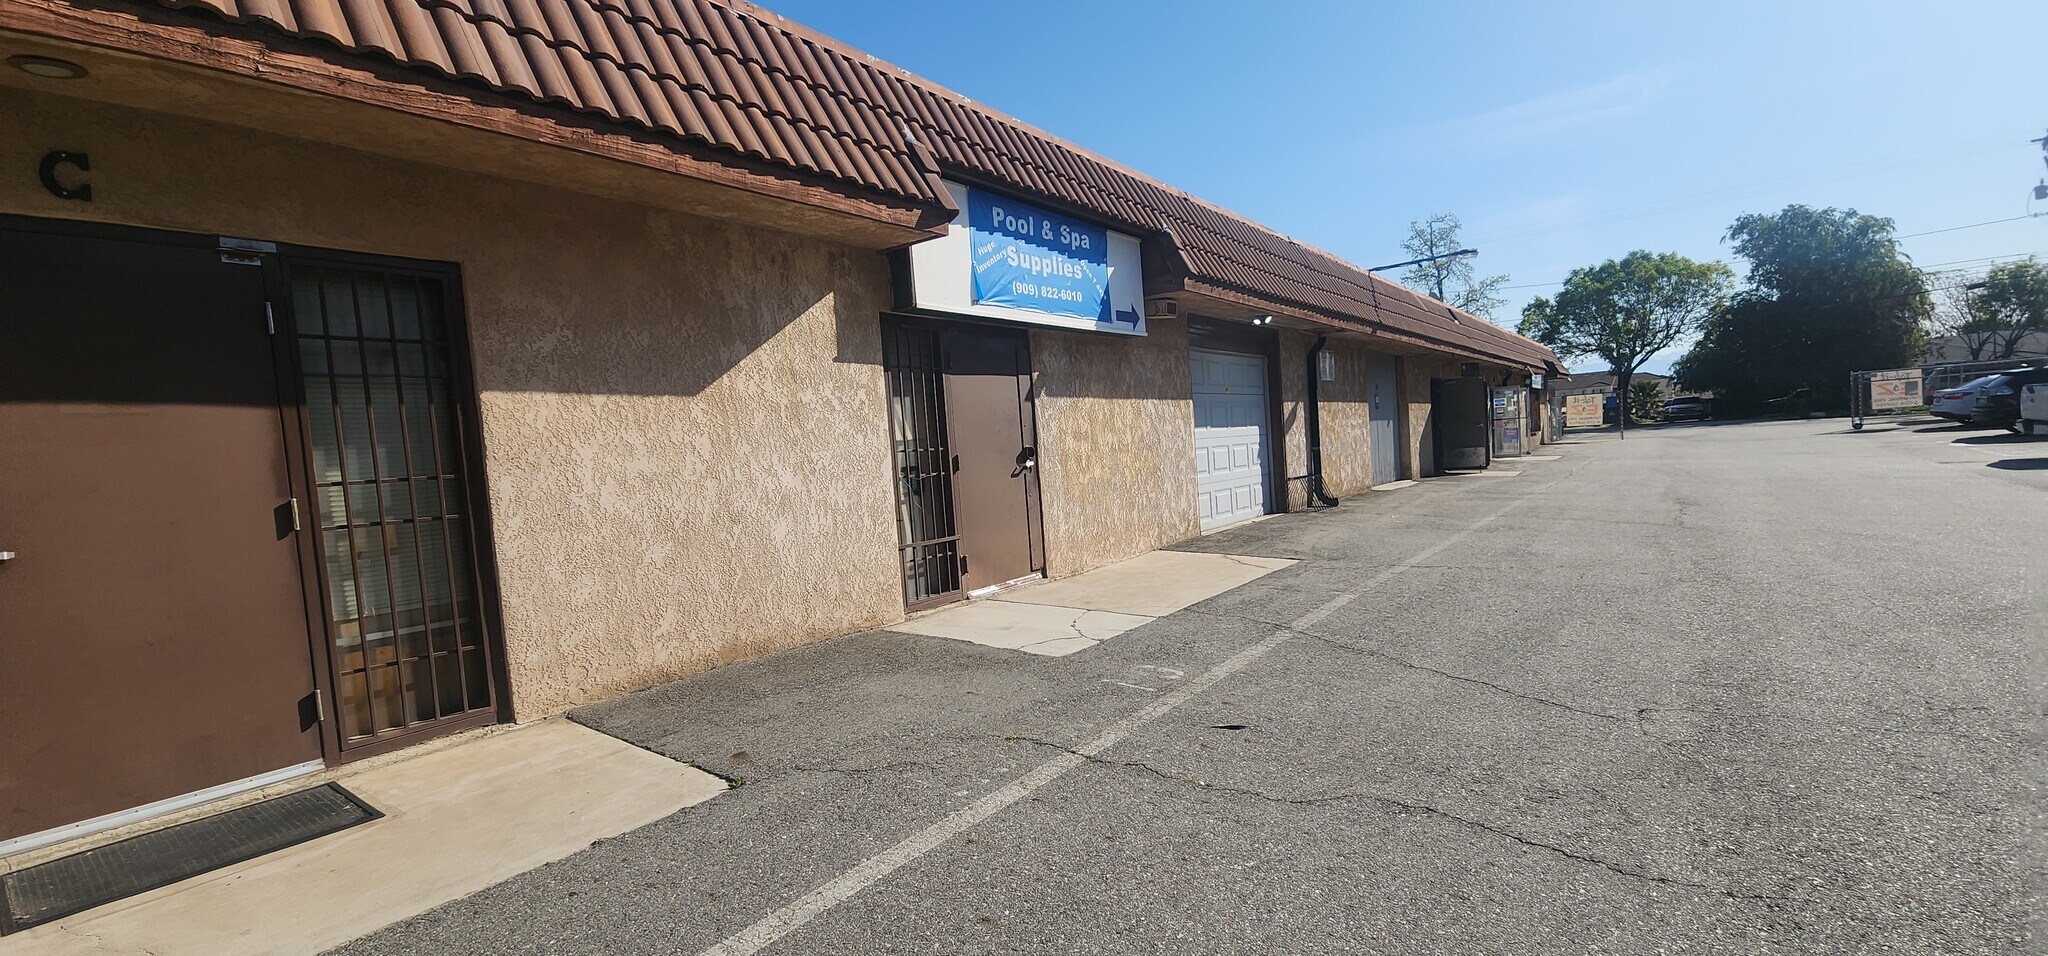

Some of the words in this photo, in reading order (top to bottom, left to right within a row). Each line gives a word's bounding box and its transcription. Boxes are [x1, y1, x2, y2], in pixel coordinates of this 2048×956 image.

[38, 150, 92, 202] C
[992, 206, 1034, 237] Pool
[1041, 219, 1054, 241] &
[1059, 224, 1090, 250] Spa
[976, 249, 1007, 274] Inventory
[978, 241, 996, 256] Huge
[1007, 244, 1083, 280] Supplies
[1012, 280, 1039, 299] (909)
[1041, 285, 1083, 303] 822-6010
